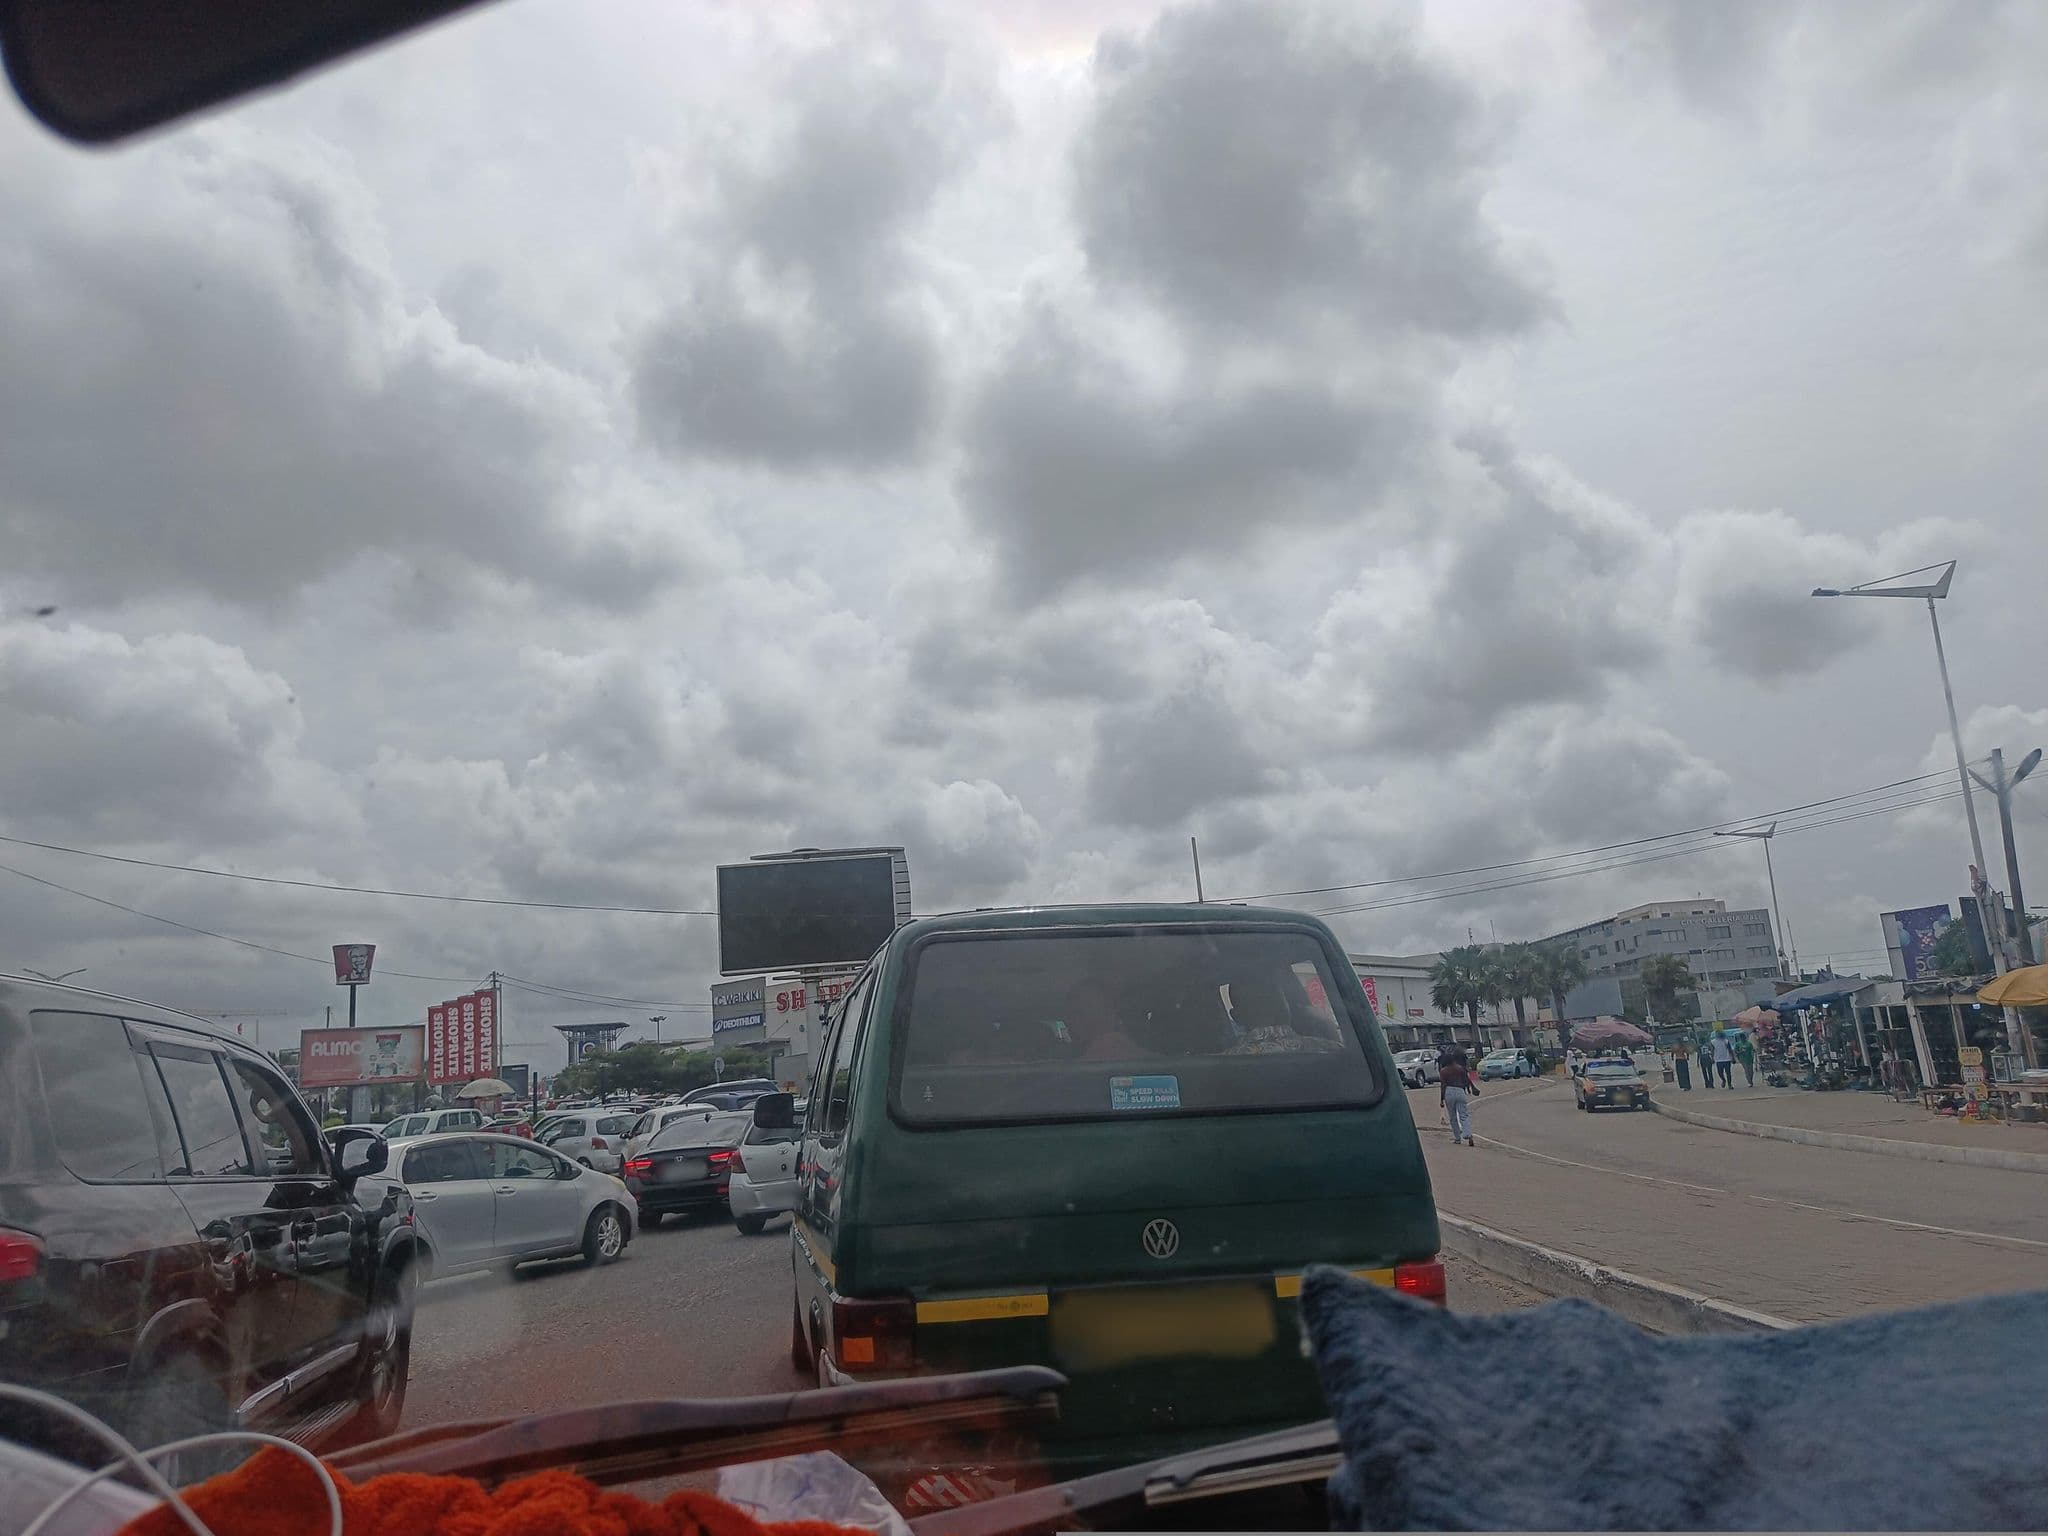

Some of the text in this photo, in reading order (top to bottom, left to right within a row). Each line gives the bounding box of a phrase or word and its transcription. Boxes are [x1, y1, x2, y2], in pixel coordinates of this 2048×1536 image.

[433, 1012, 444, 1079] SHOPRITE
[448, 1007, 459, 1076] SHOPRITE
[463, 1002, 475, 1075] SHOPRITE
[480, 997, 492, 1072] SHOPRITE
[1131, 1095, 1153, 1103] SLOW
[1155, 1095, 1177, 1103] DOWN
